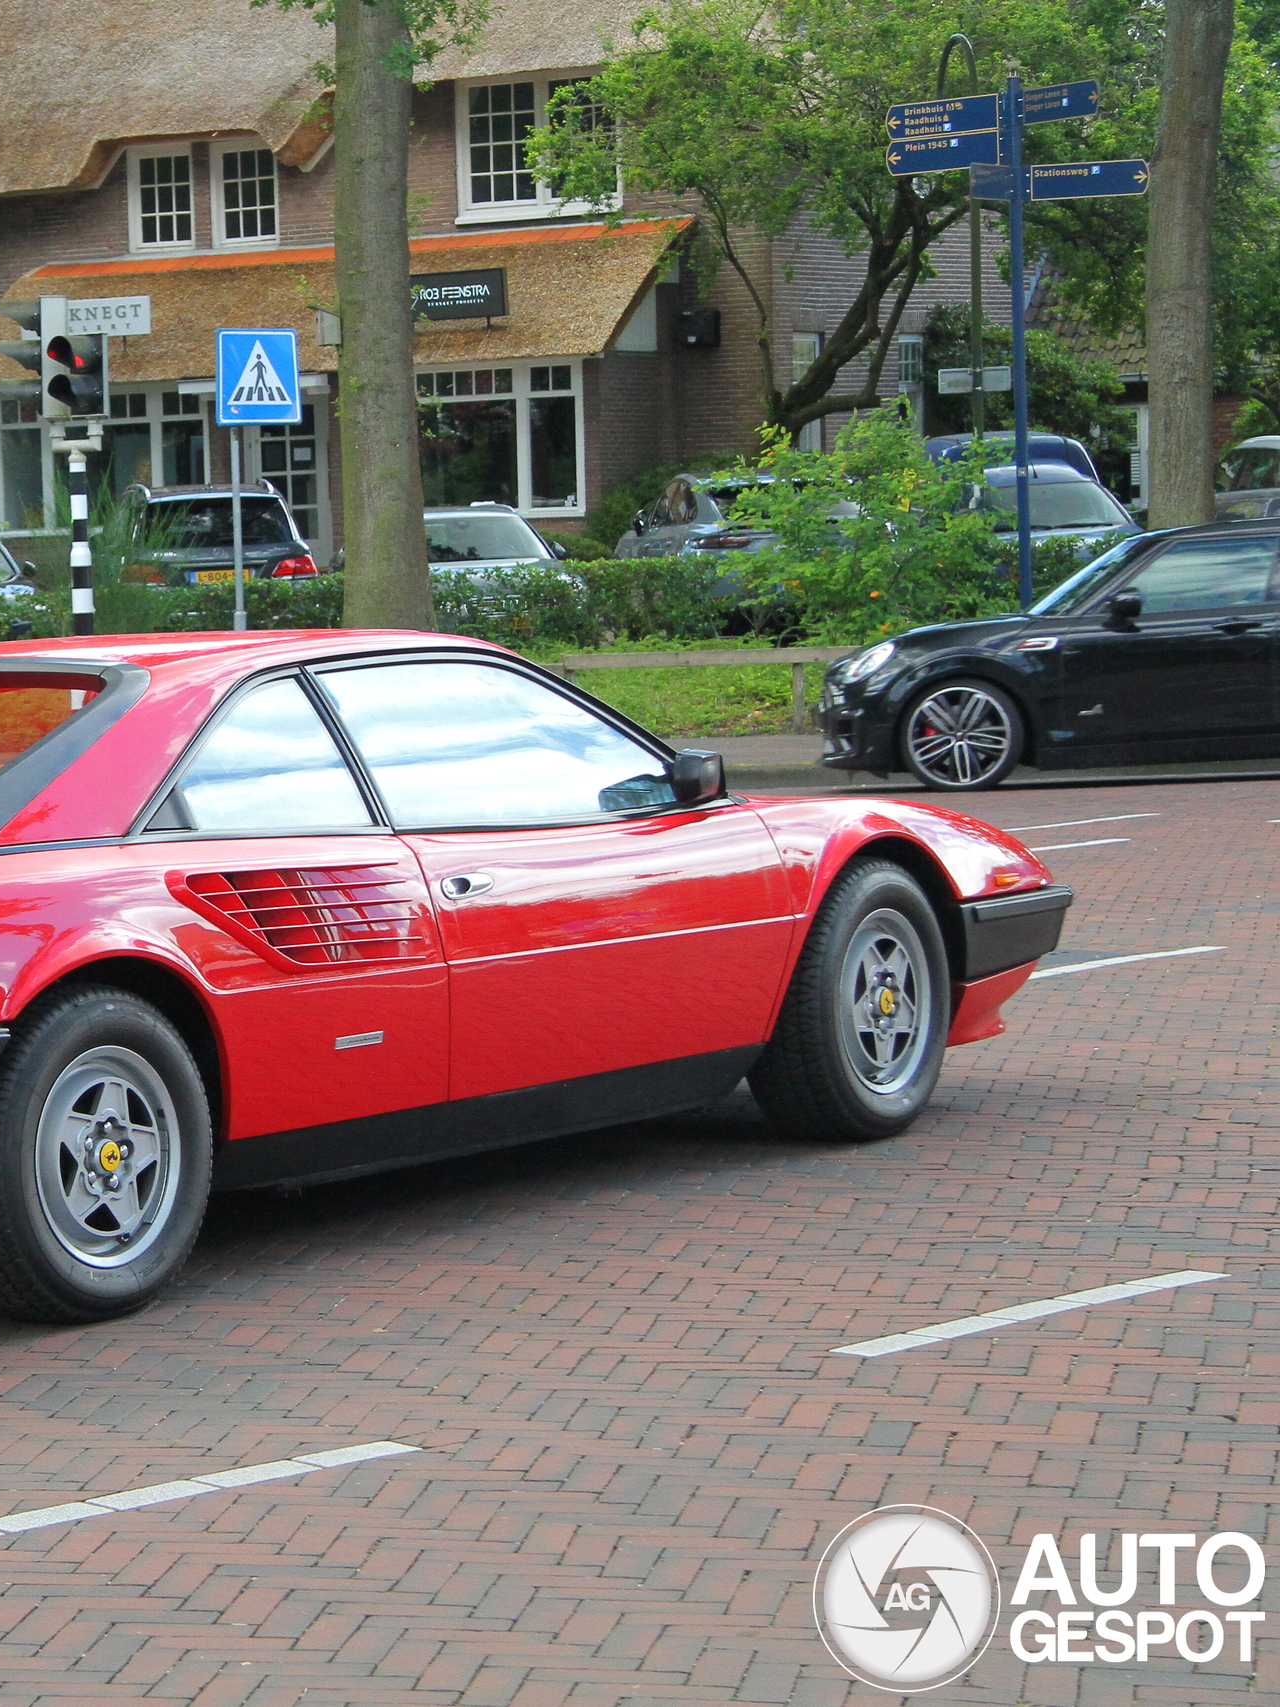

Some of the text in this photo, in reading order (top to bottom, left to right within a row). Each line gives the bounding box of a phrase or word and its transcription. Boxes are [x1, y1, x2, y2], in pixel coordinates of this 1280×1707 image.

[904, 106, 943, 116] Brinkhuis
[904, 115, 942, 126] Raadhuis
[904, 124, 942, 136] Raadhuis
[905, 143, 926, 152] Plein
[927, 140, 948, 149] 1945
[1034, 168, 1089, 178] Stationsweg
[68, 303, 141, 321] KNEGT
[68, 322, 131, 332] LLERY
